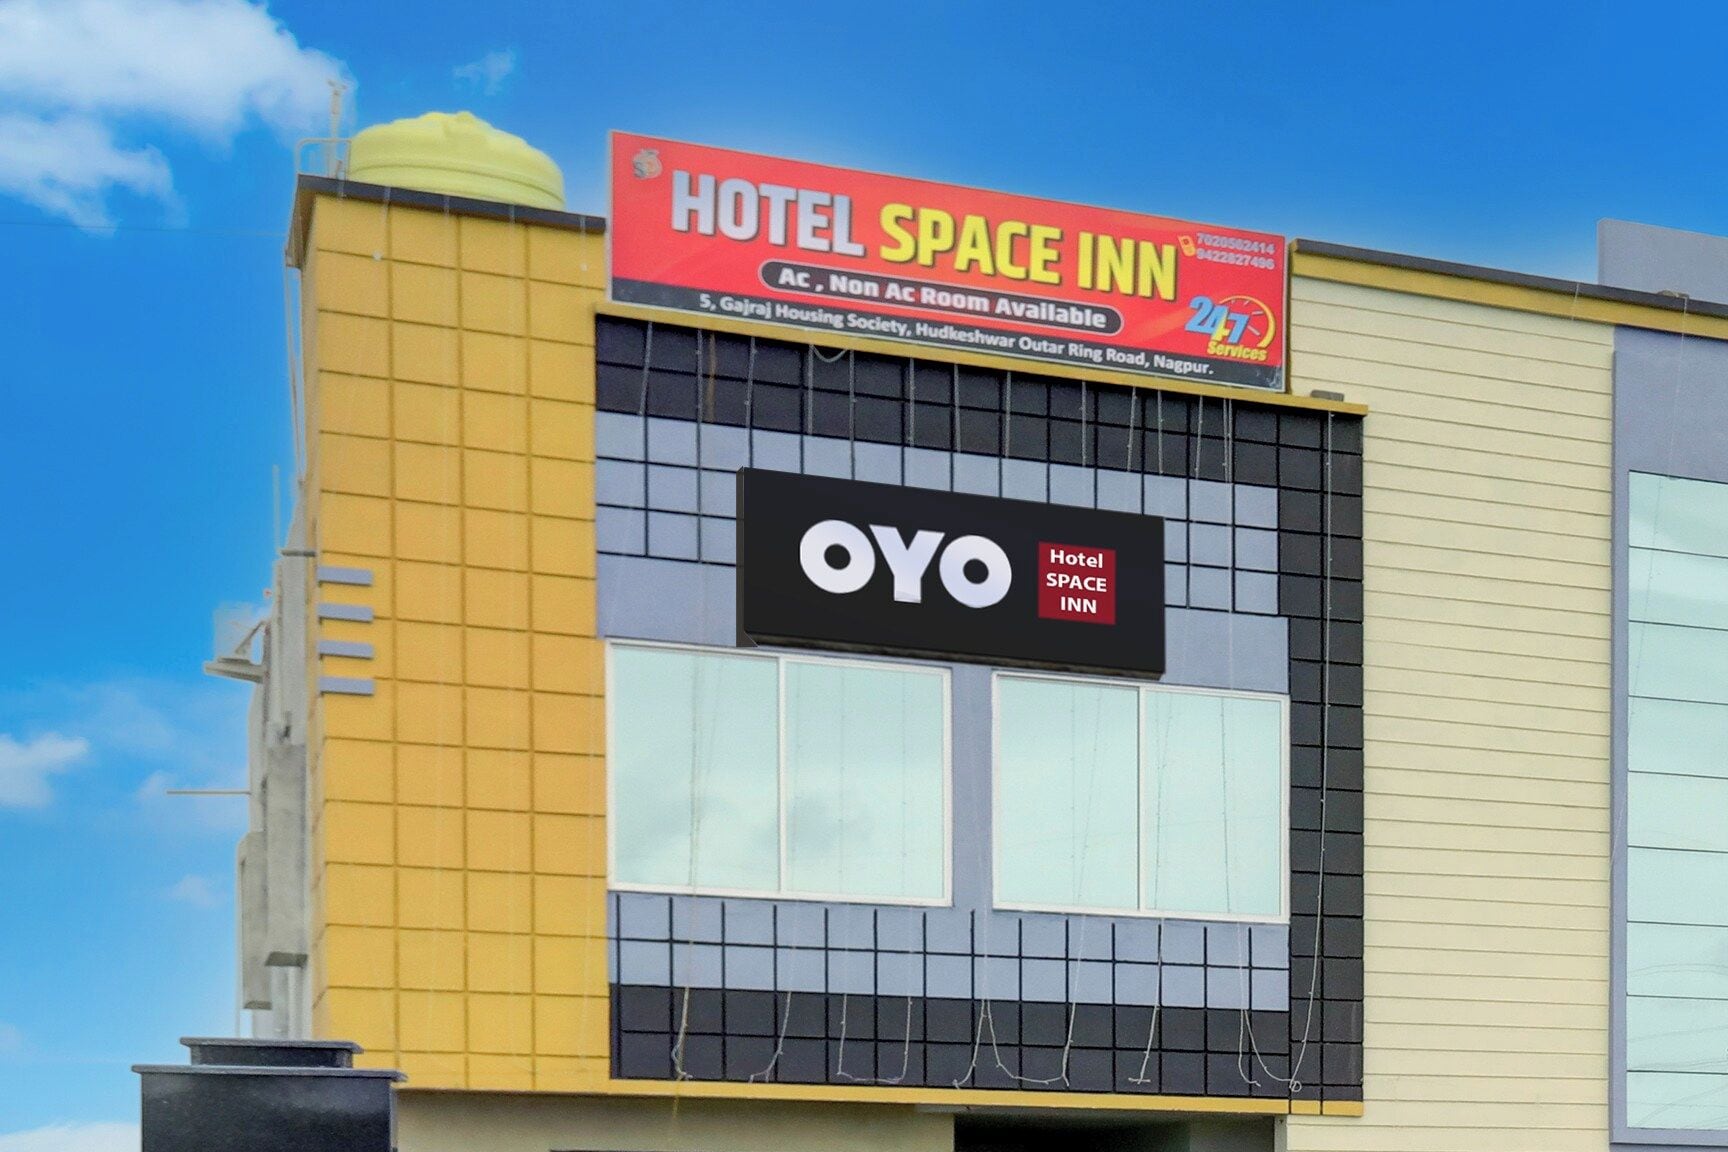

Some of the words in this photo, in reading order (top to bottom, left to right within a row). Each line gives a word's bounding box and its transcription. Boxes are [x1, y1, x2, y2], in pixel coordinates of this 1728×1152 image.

[671, 170, 866, 258] HOTEL
[879, 203, 1062, 285] SPACE
[1077, 230, 1178, 301] INN
[828, 273, 879, 298] Non
[919, 286, 990, 313] Room
[993, 296, 1107, 329] Available
[720, 295, 772, 319] Gajraj
[775, 302, 844, 329] Housing
[846, 313, 912, 337] Society,
[915, 322, 1015, 348] Hudkeshwar
[1018, 336, 1065, 355] Outar
[1067, 342, 1103, 363] Ring
[1105, 347, 1151, 369] Road,
[1153, 353, 1214, 375] Nagpur.
[1206, 340, 1268, 362] Services
[799, 518, 1013, 609] OYO
[1049, 548, 1104, 569] Hotel
[1046, 572, 1107, 593] SPACE
[1060, 596, 1097, 614] INN
